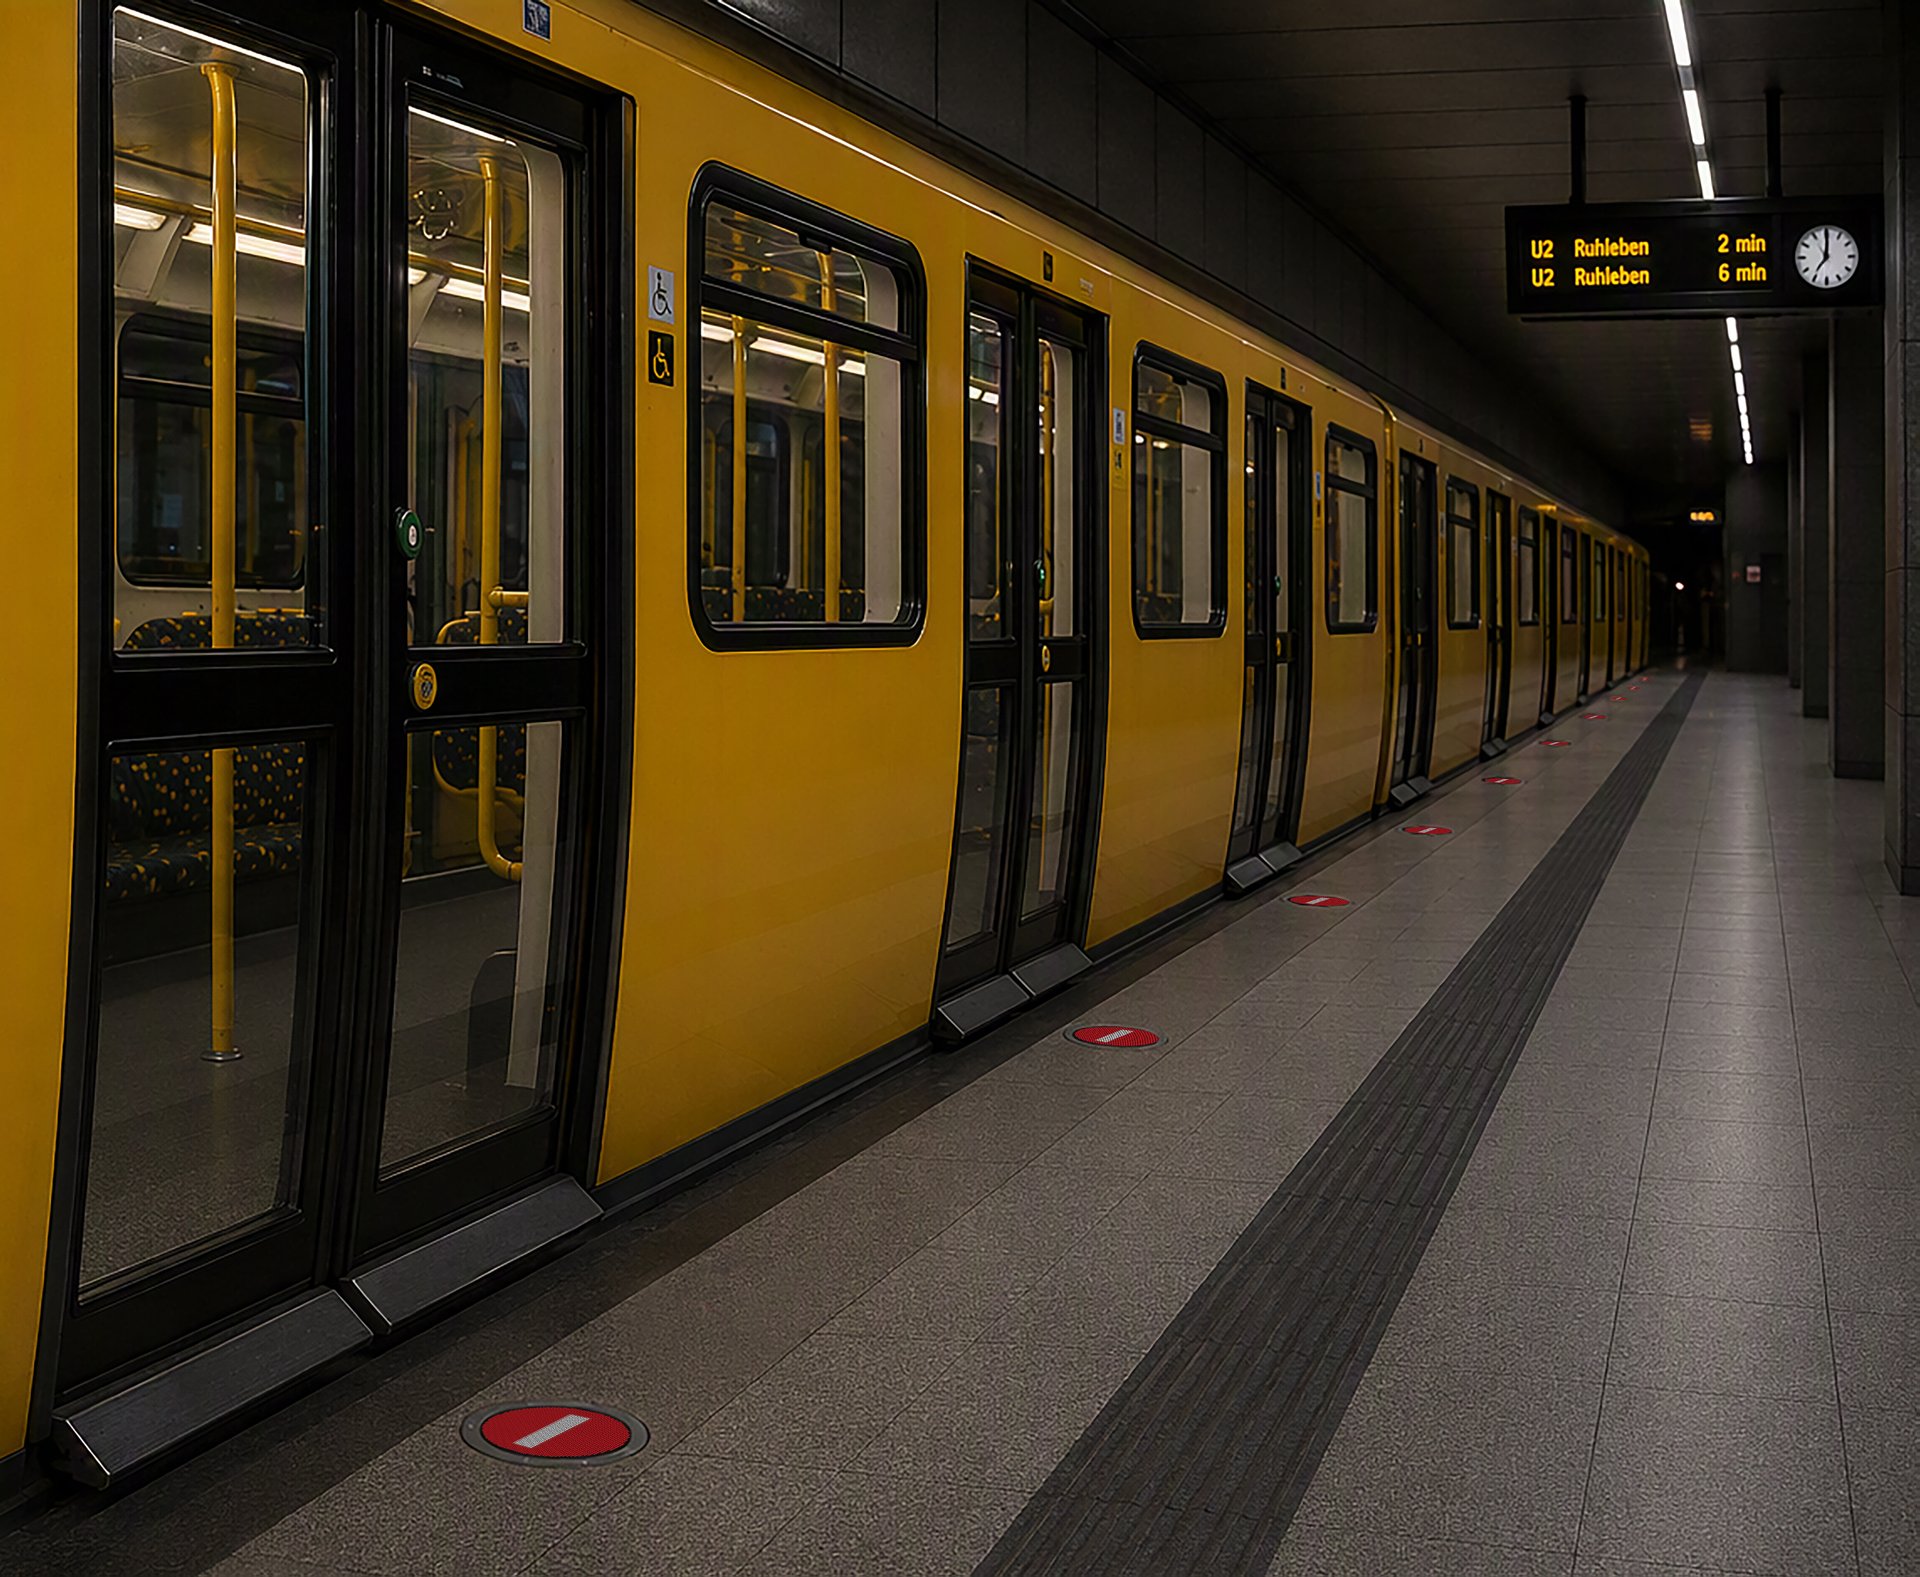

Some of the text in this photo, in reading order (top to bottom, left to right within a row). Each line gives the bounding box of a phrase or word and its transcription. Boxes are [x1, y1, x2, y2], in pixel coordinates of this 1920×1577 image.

[1531, 233, 1767, 259] U2 Ruhleben 2 min
[1531, 261, 1767, 288] U2 Ruhleben 6 min
